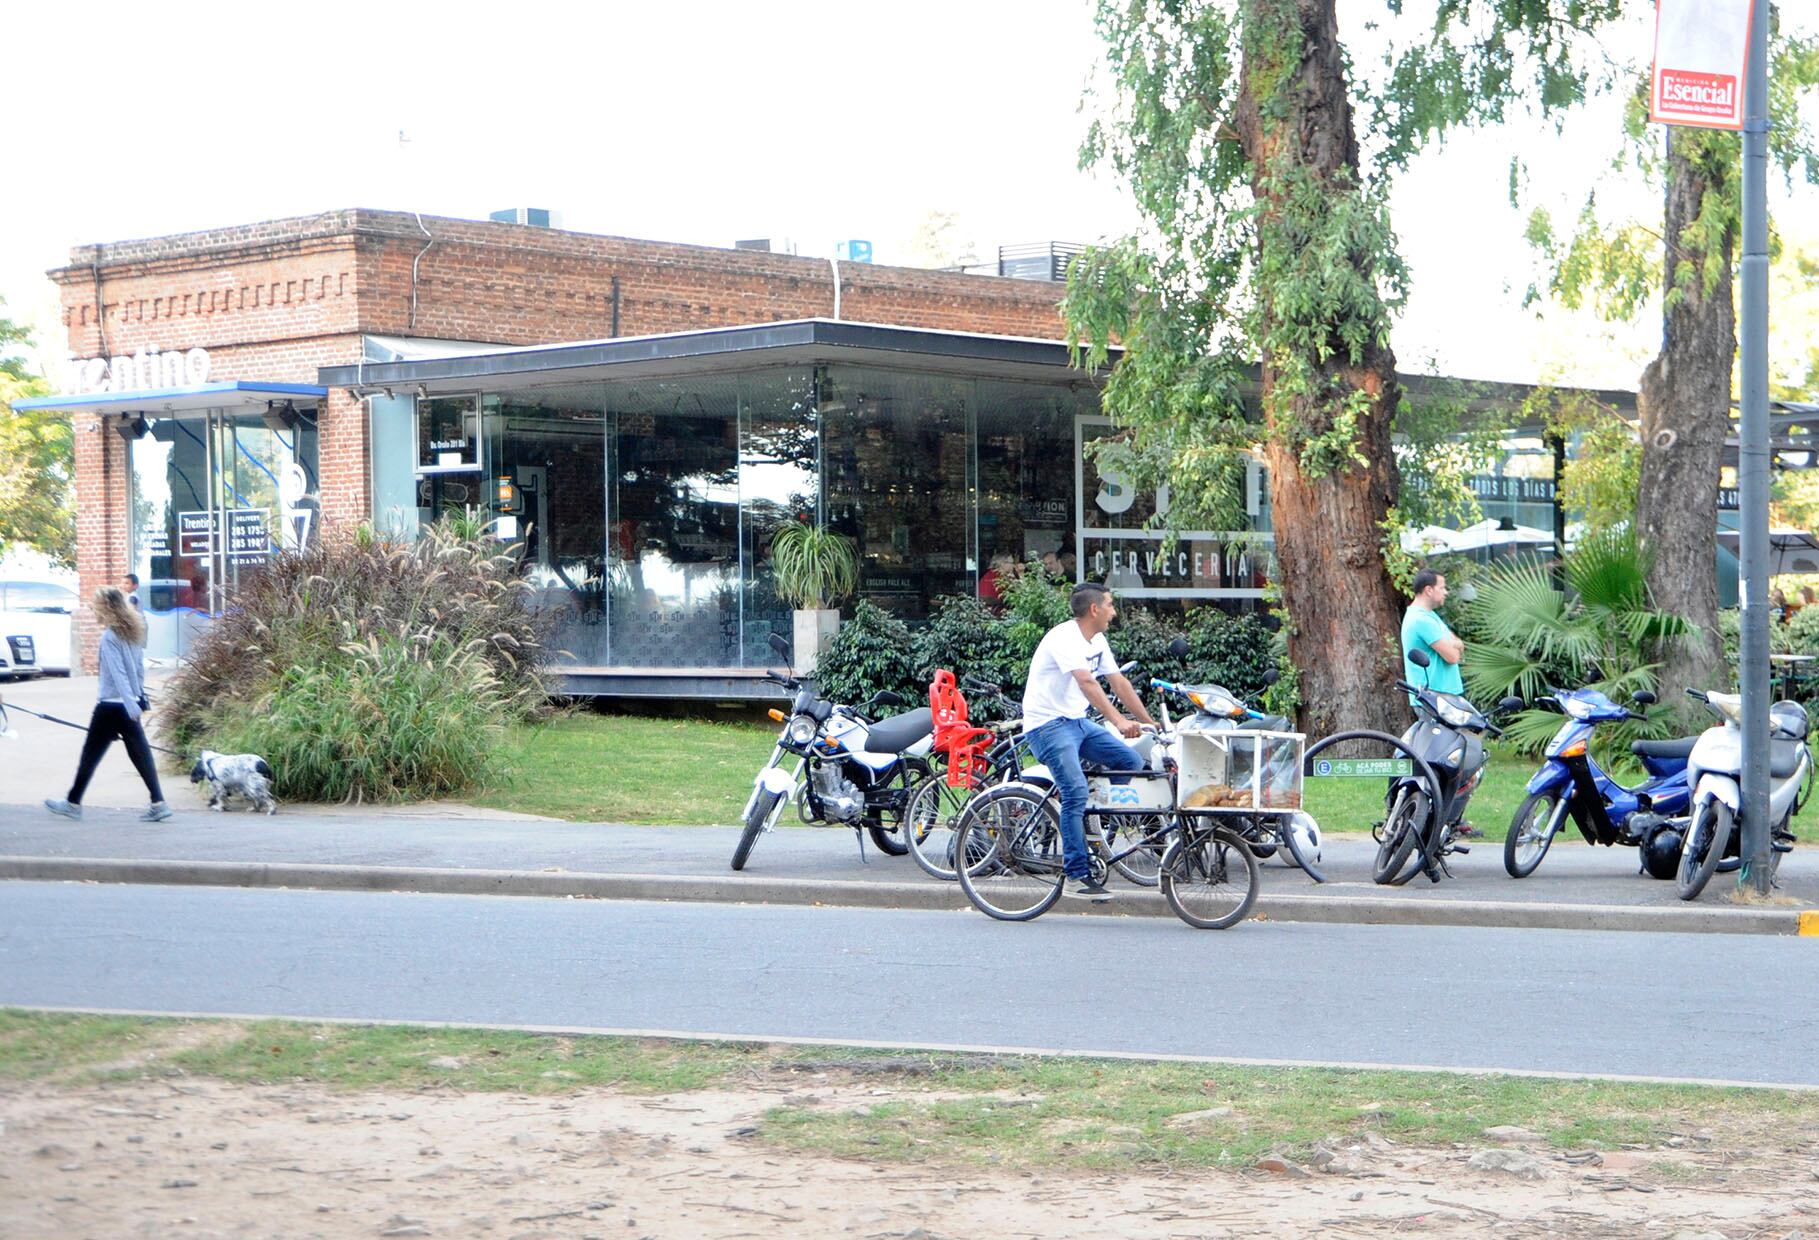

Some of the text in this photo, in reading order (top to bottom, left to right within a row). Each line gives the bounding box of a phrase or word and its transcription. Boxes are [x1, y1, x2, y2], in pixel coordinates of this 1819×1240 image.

[1662, 76, 1733, 105] Esencial
[1095, 551, 1247, 577] CERVECERIA
[1321, 763, 1328, 773] E
